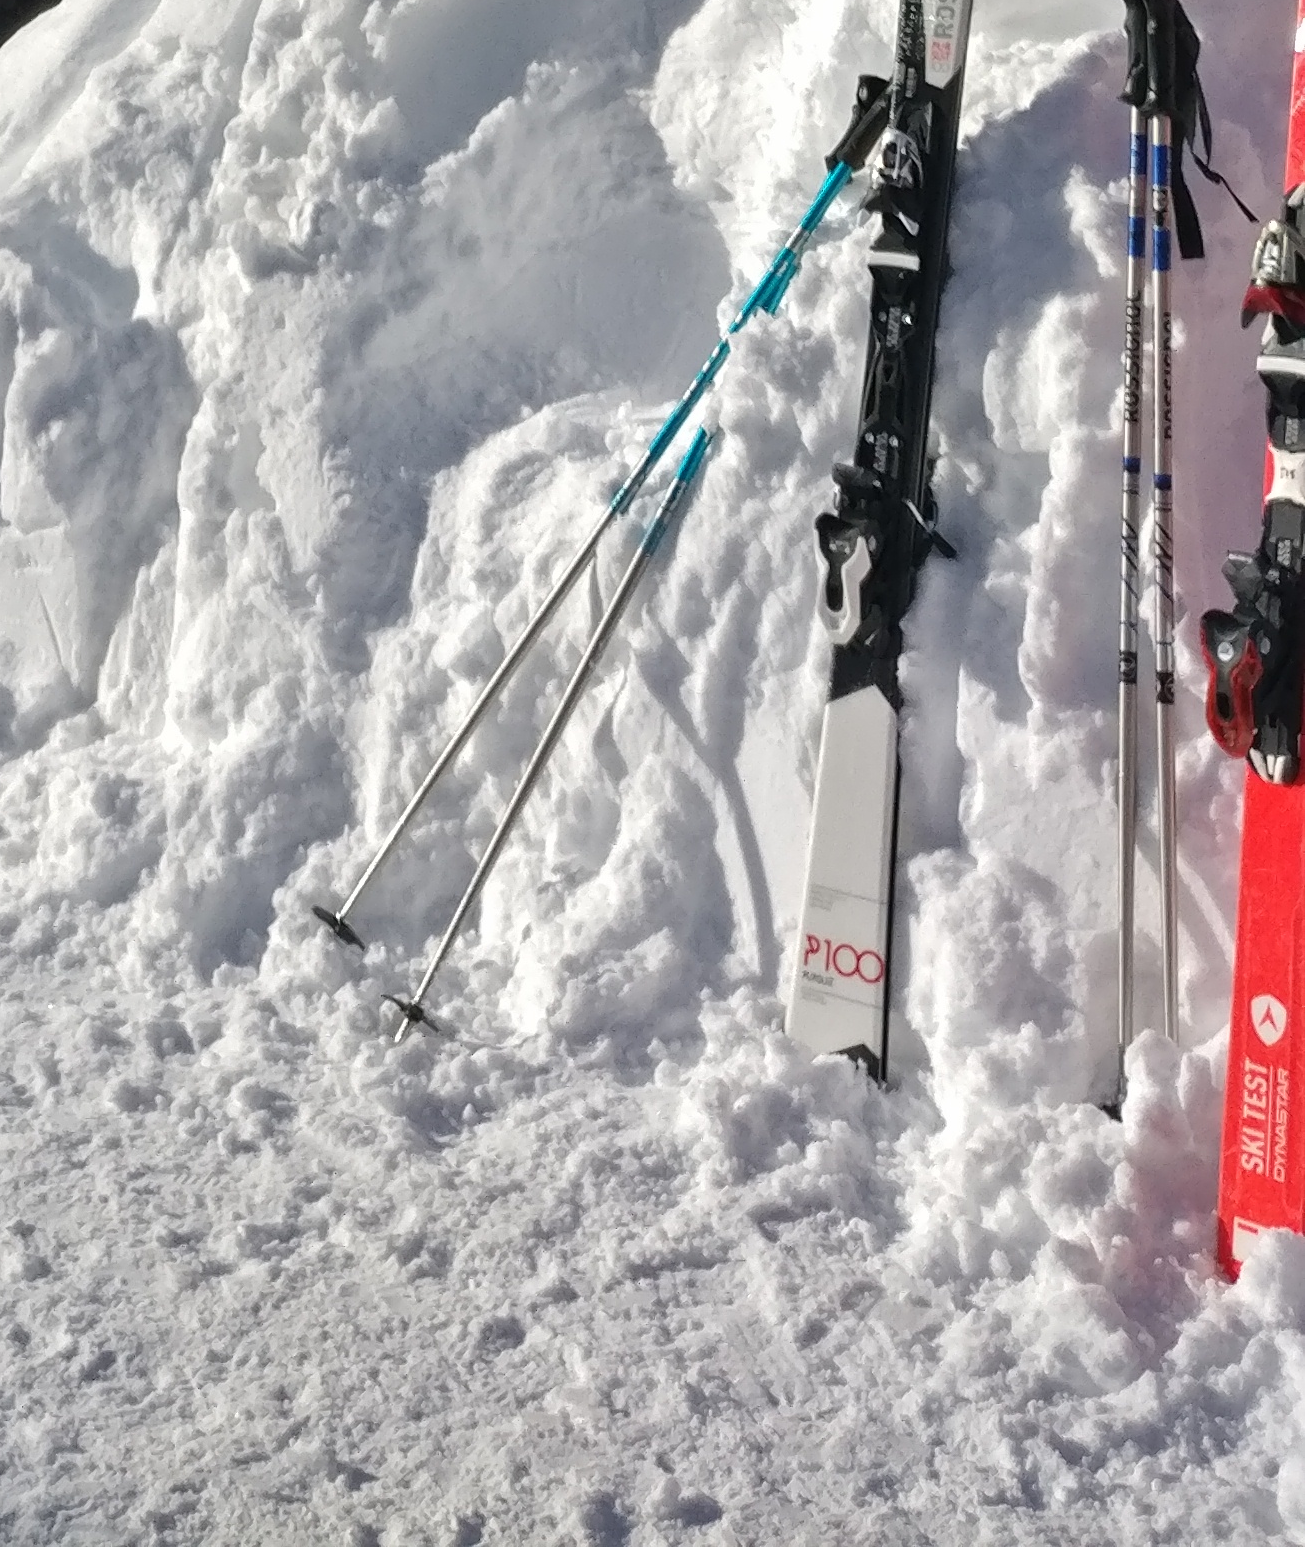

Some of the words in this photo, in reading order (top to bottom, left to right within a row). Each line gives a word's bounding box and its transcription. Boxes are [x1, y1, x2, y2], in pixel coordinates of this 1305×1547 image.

[803, 934, 886, 984] P100
[1242, 1054, 1270, 1121] TEST
[1240, 1126, 1266, 1176] SKI
[1272, 1066, 1290, 1184] DYNASTAR
